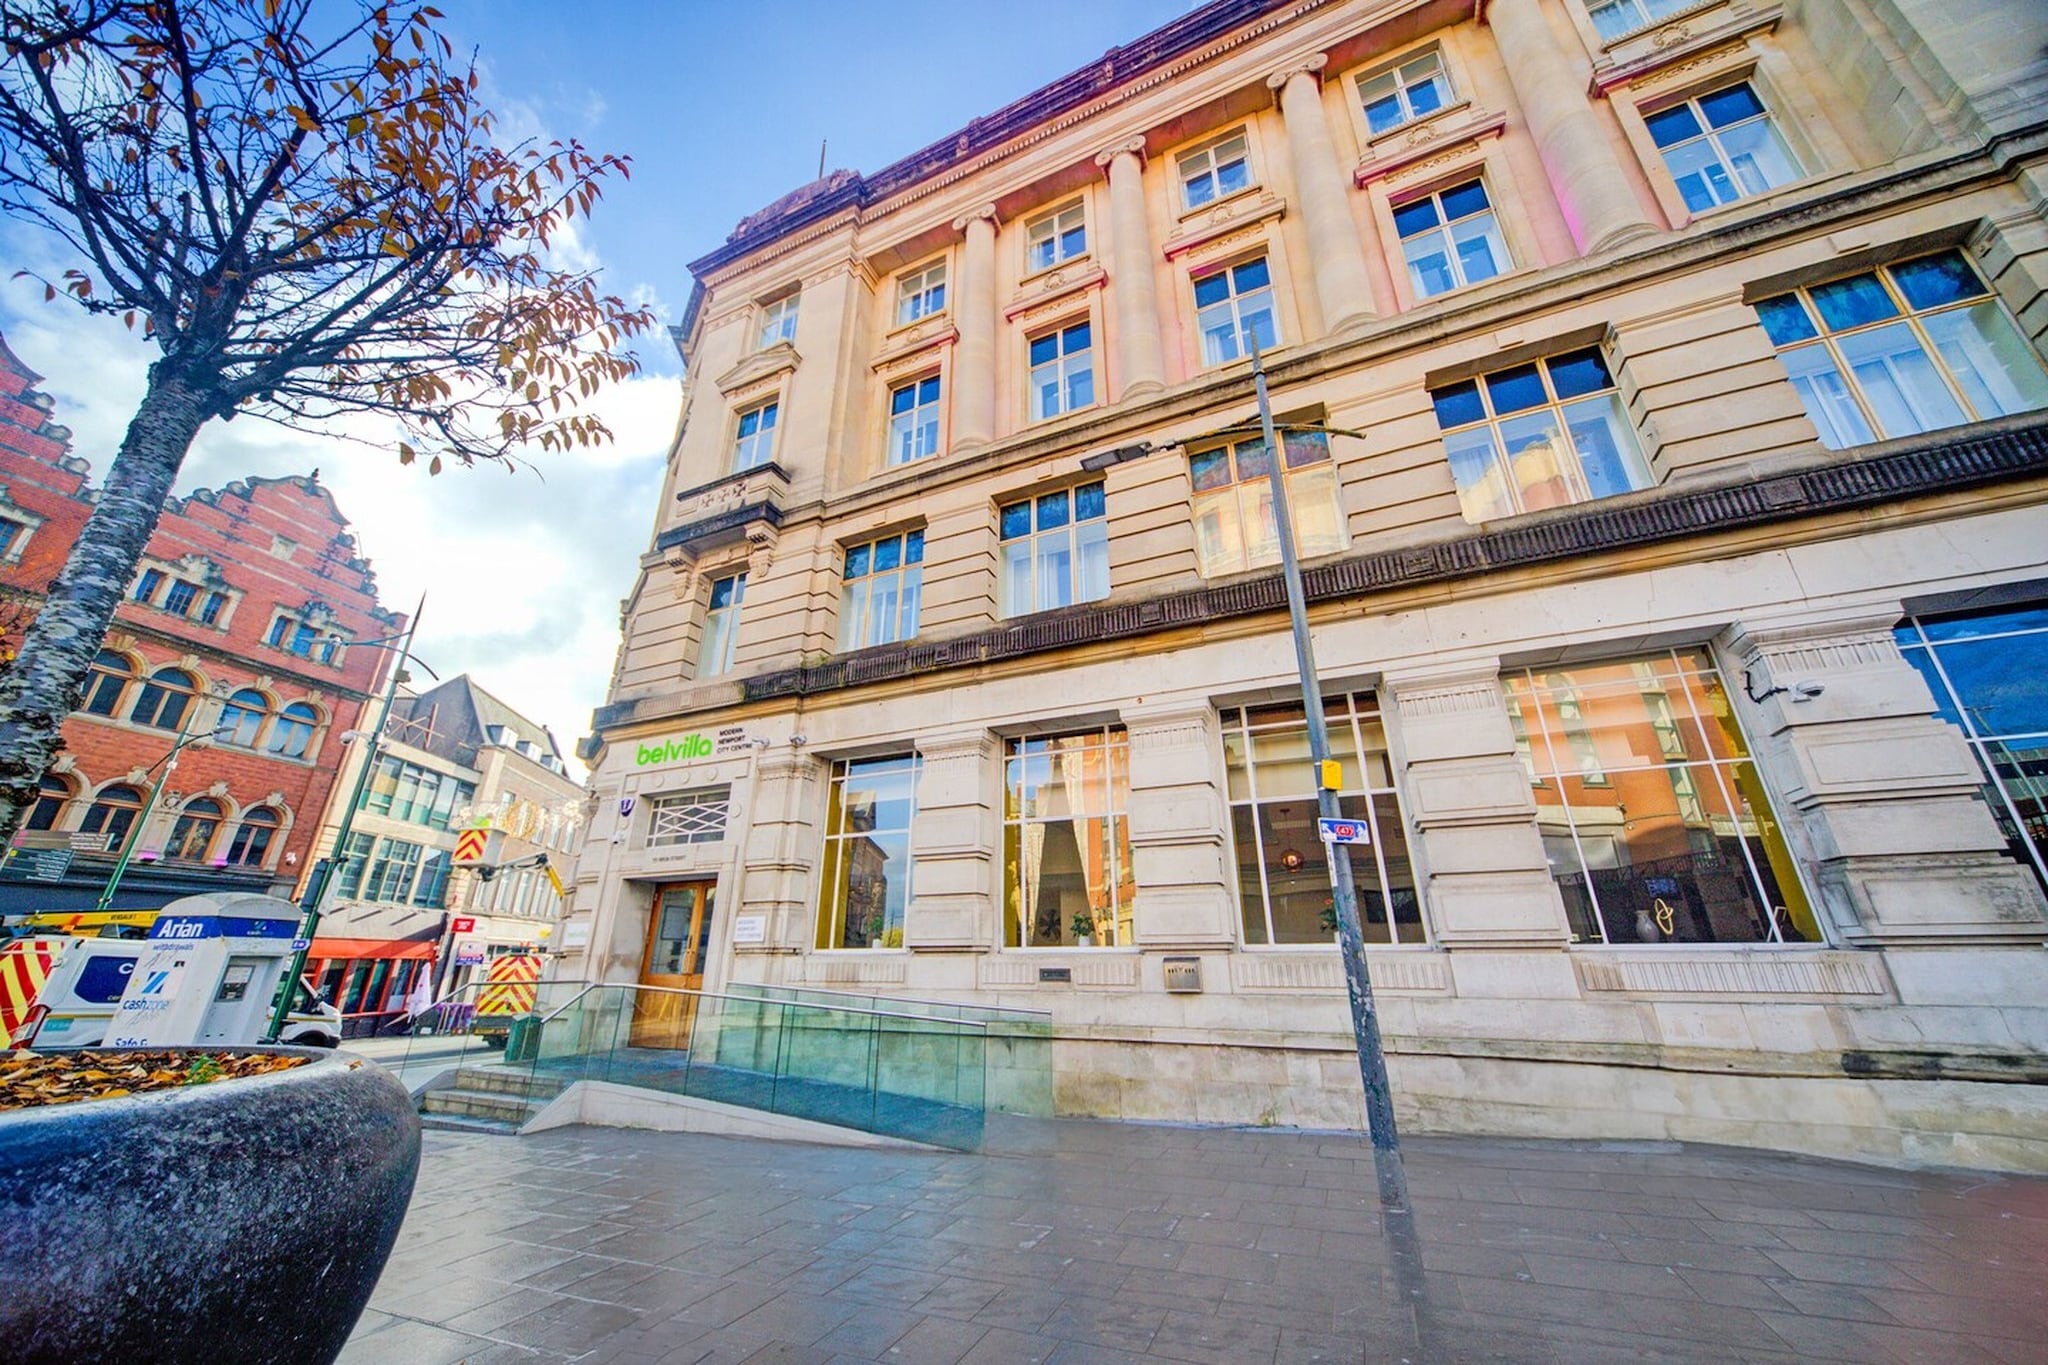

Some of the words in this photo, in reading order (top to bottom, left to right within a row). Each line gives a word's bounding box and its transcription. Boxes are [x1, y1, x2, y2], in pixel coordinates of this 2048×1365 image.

[718, 735, 746, 745] NEWPORT
[637, 734, 713, 766] belvilla
[157, 918, 204, 938] Arian
[123, 997, 170, 1011] cashzone
